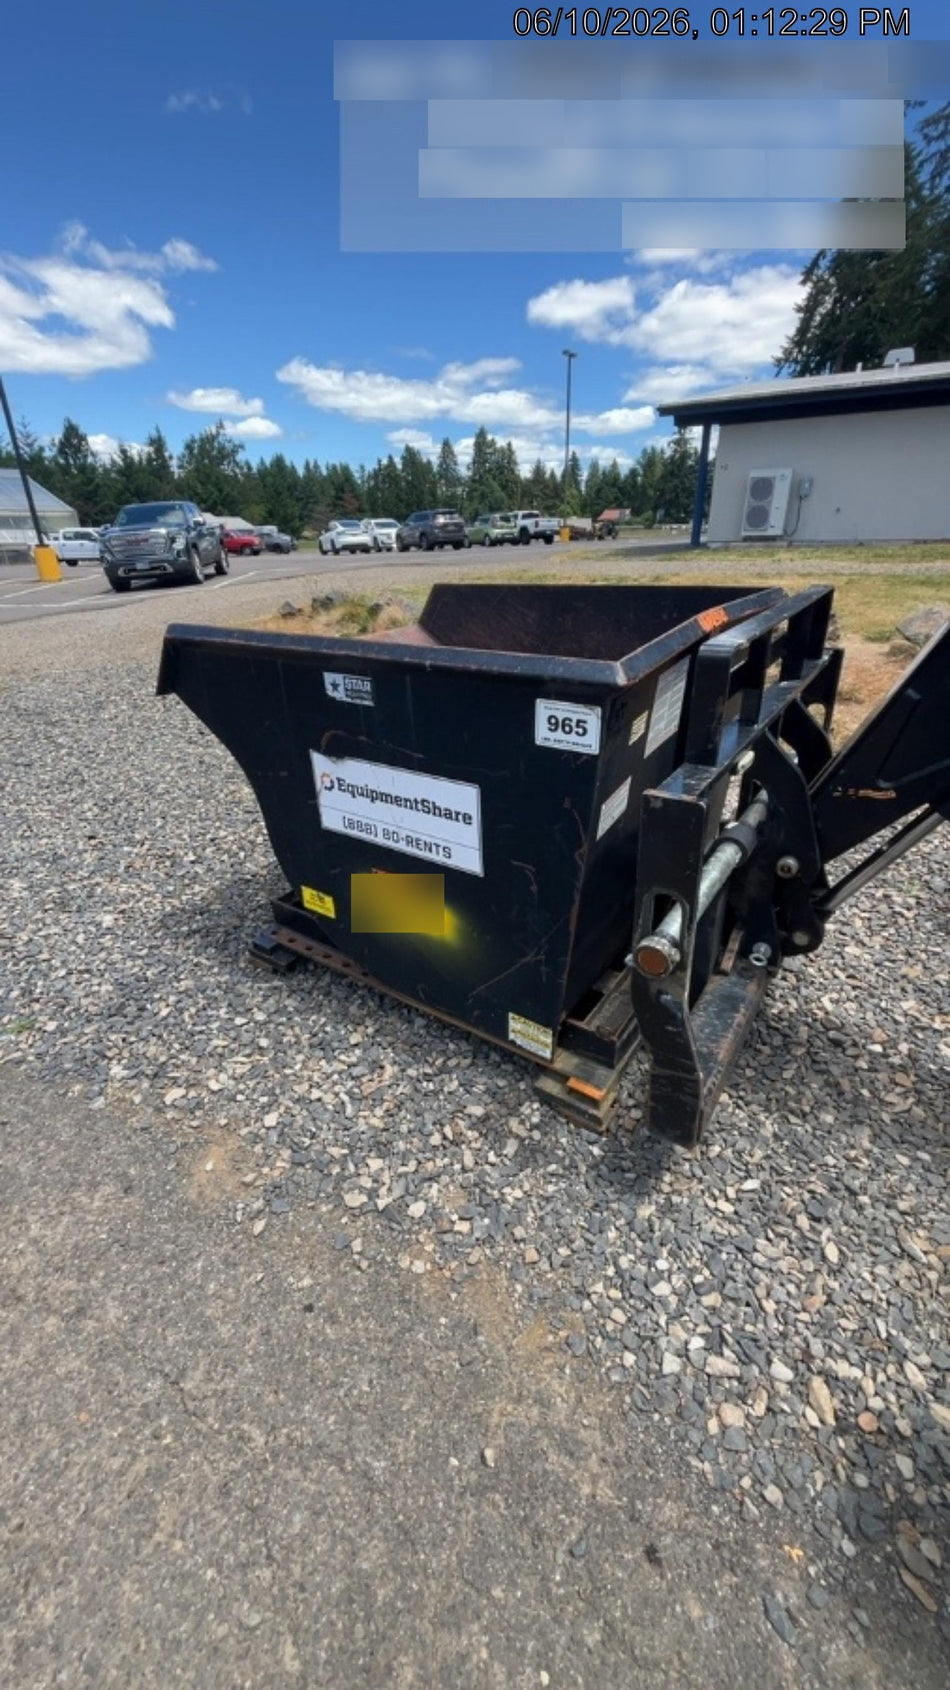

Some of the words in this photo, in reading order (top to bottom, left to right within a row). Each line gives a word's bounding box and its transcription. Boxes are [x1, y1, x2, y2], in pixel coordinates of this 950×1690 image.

[345, 677, 372, 692] STAR
[547, 714, 588, 737] 965
[335, 776, 473, 825] EquipmentShare
[342, 815, 378, 838] (888)
